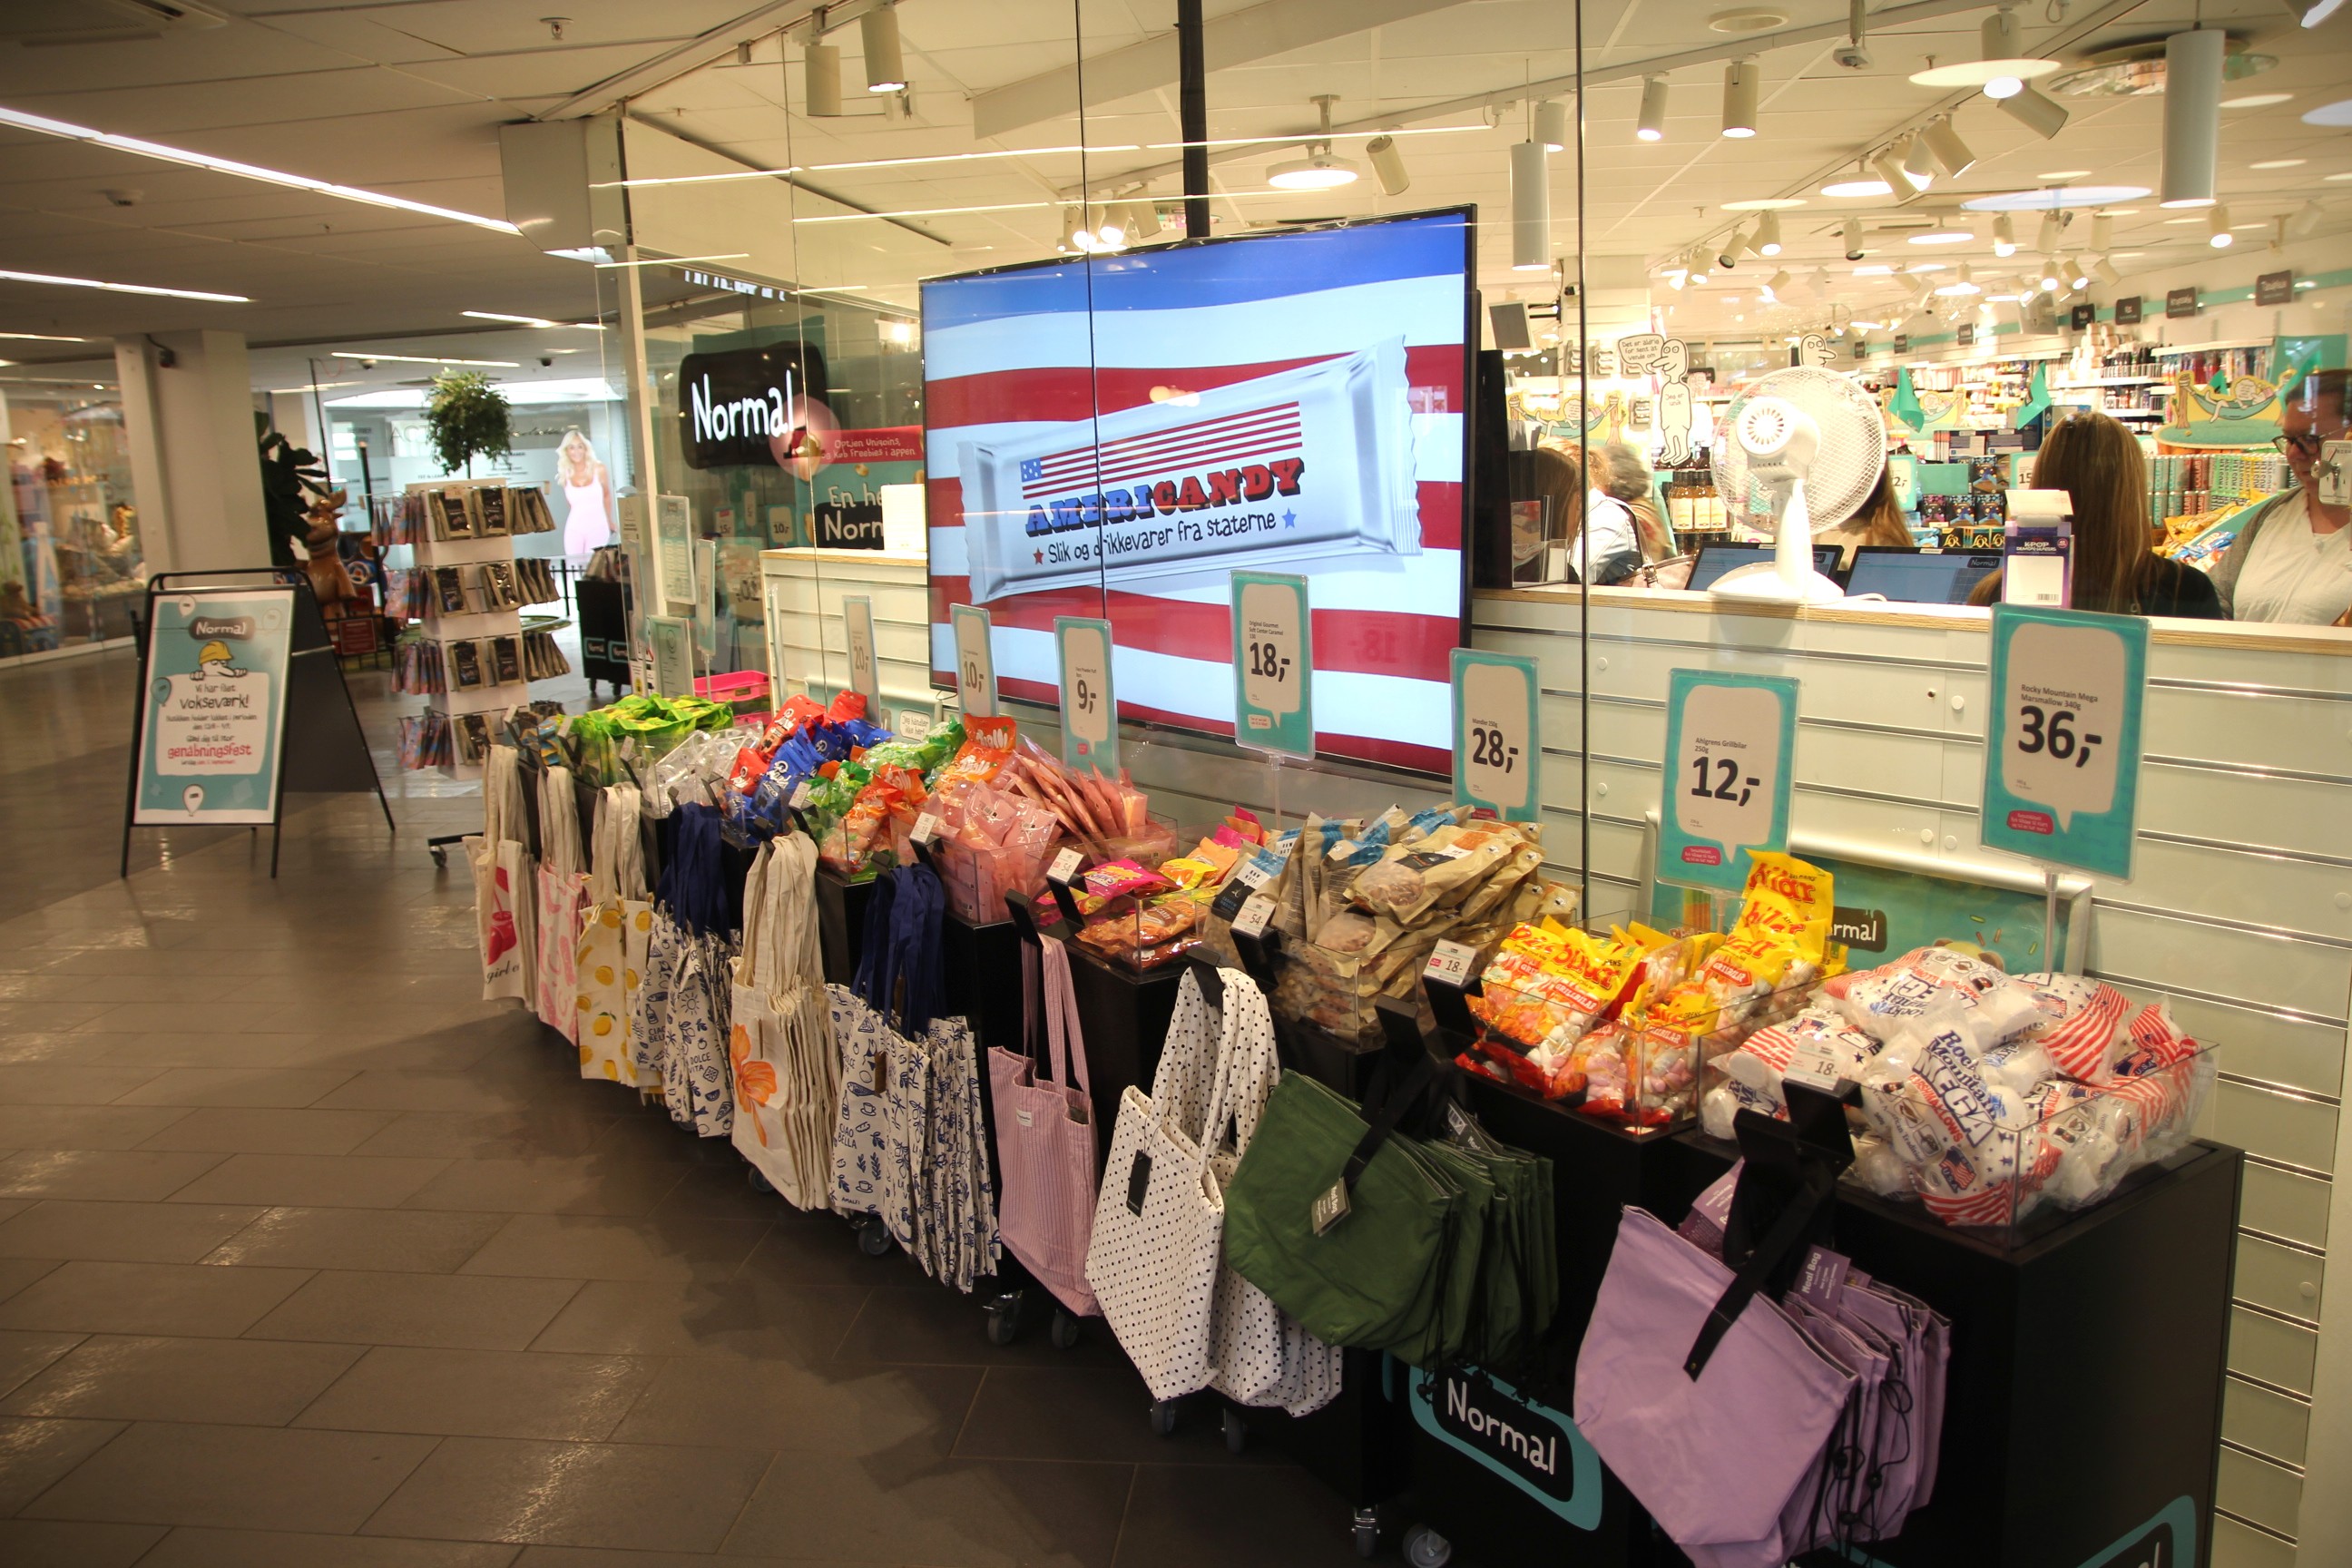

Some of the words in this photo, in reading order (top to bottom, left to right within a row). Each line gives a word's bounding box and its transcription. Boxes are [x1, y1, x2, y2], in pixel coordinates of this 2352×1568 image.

[691, 369, 794, 443] Normal
[890, 448, 916, 456] appen
[828, 485, 857, 508] En
[1025, 456, 1305, 537] AMERICANDY
[1048, 541, 1072, 564] Slik
[1074, 545, 1089, 562] og
[1178, 520, 1203, 542] fra
[1207, 512, 1277, 537] staterne
[1971, 558, 1996, 566] Normal
[196, 622, 247, 635] Normal
[1250, 642, 1290, 682] 18,-
[964, 661, 985, 692] 10,-
[1077, 680, 1096, 714] 9,-
[2021, 684, 2042, 694] Rocky
[2043, 687, 2077, 699] Mountain
[2078, 692, 2098, 702] Mega
[2021, 694, 2063, 707] Marsmallow
[2063, 700, 2082, 710] 340g
[1695, 737, 1720, 748] Ahlgrens
[1721, 740, 1748, 750] Grillbilar
[2018, 705, 2102, 768] 36,-
[1473, 728, 1519, 773] 28,-
[1694, 745, 1709, 754] 250g
[1691, 756, 1760, 807] 12,-
[1834, 920, 1877, 942] rmal
[486, 960, 510, 985] girl
[691, 1053, 711, 1064] DOLCE
[1815, 1060, 1838, 1076] 18-
[838, 1132, 858, 1149] BELLA
[839, 1123, 854, 1138] CIAO
[841, 1197, 860, 1205] AMALFI
[1807, 1252, 1822, 1271] Bag
[1801, 1271, 1814, 1293] Meal
[1447, 1377, 1555, 1475] Normal
